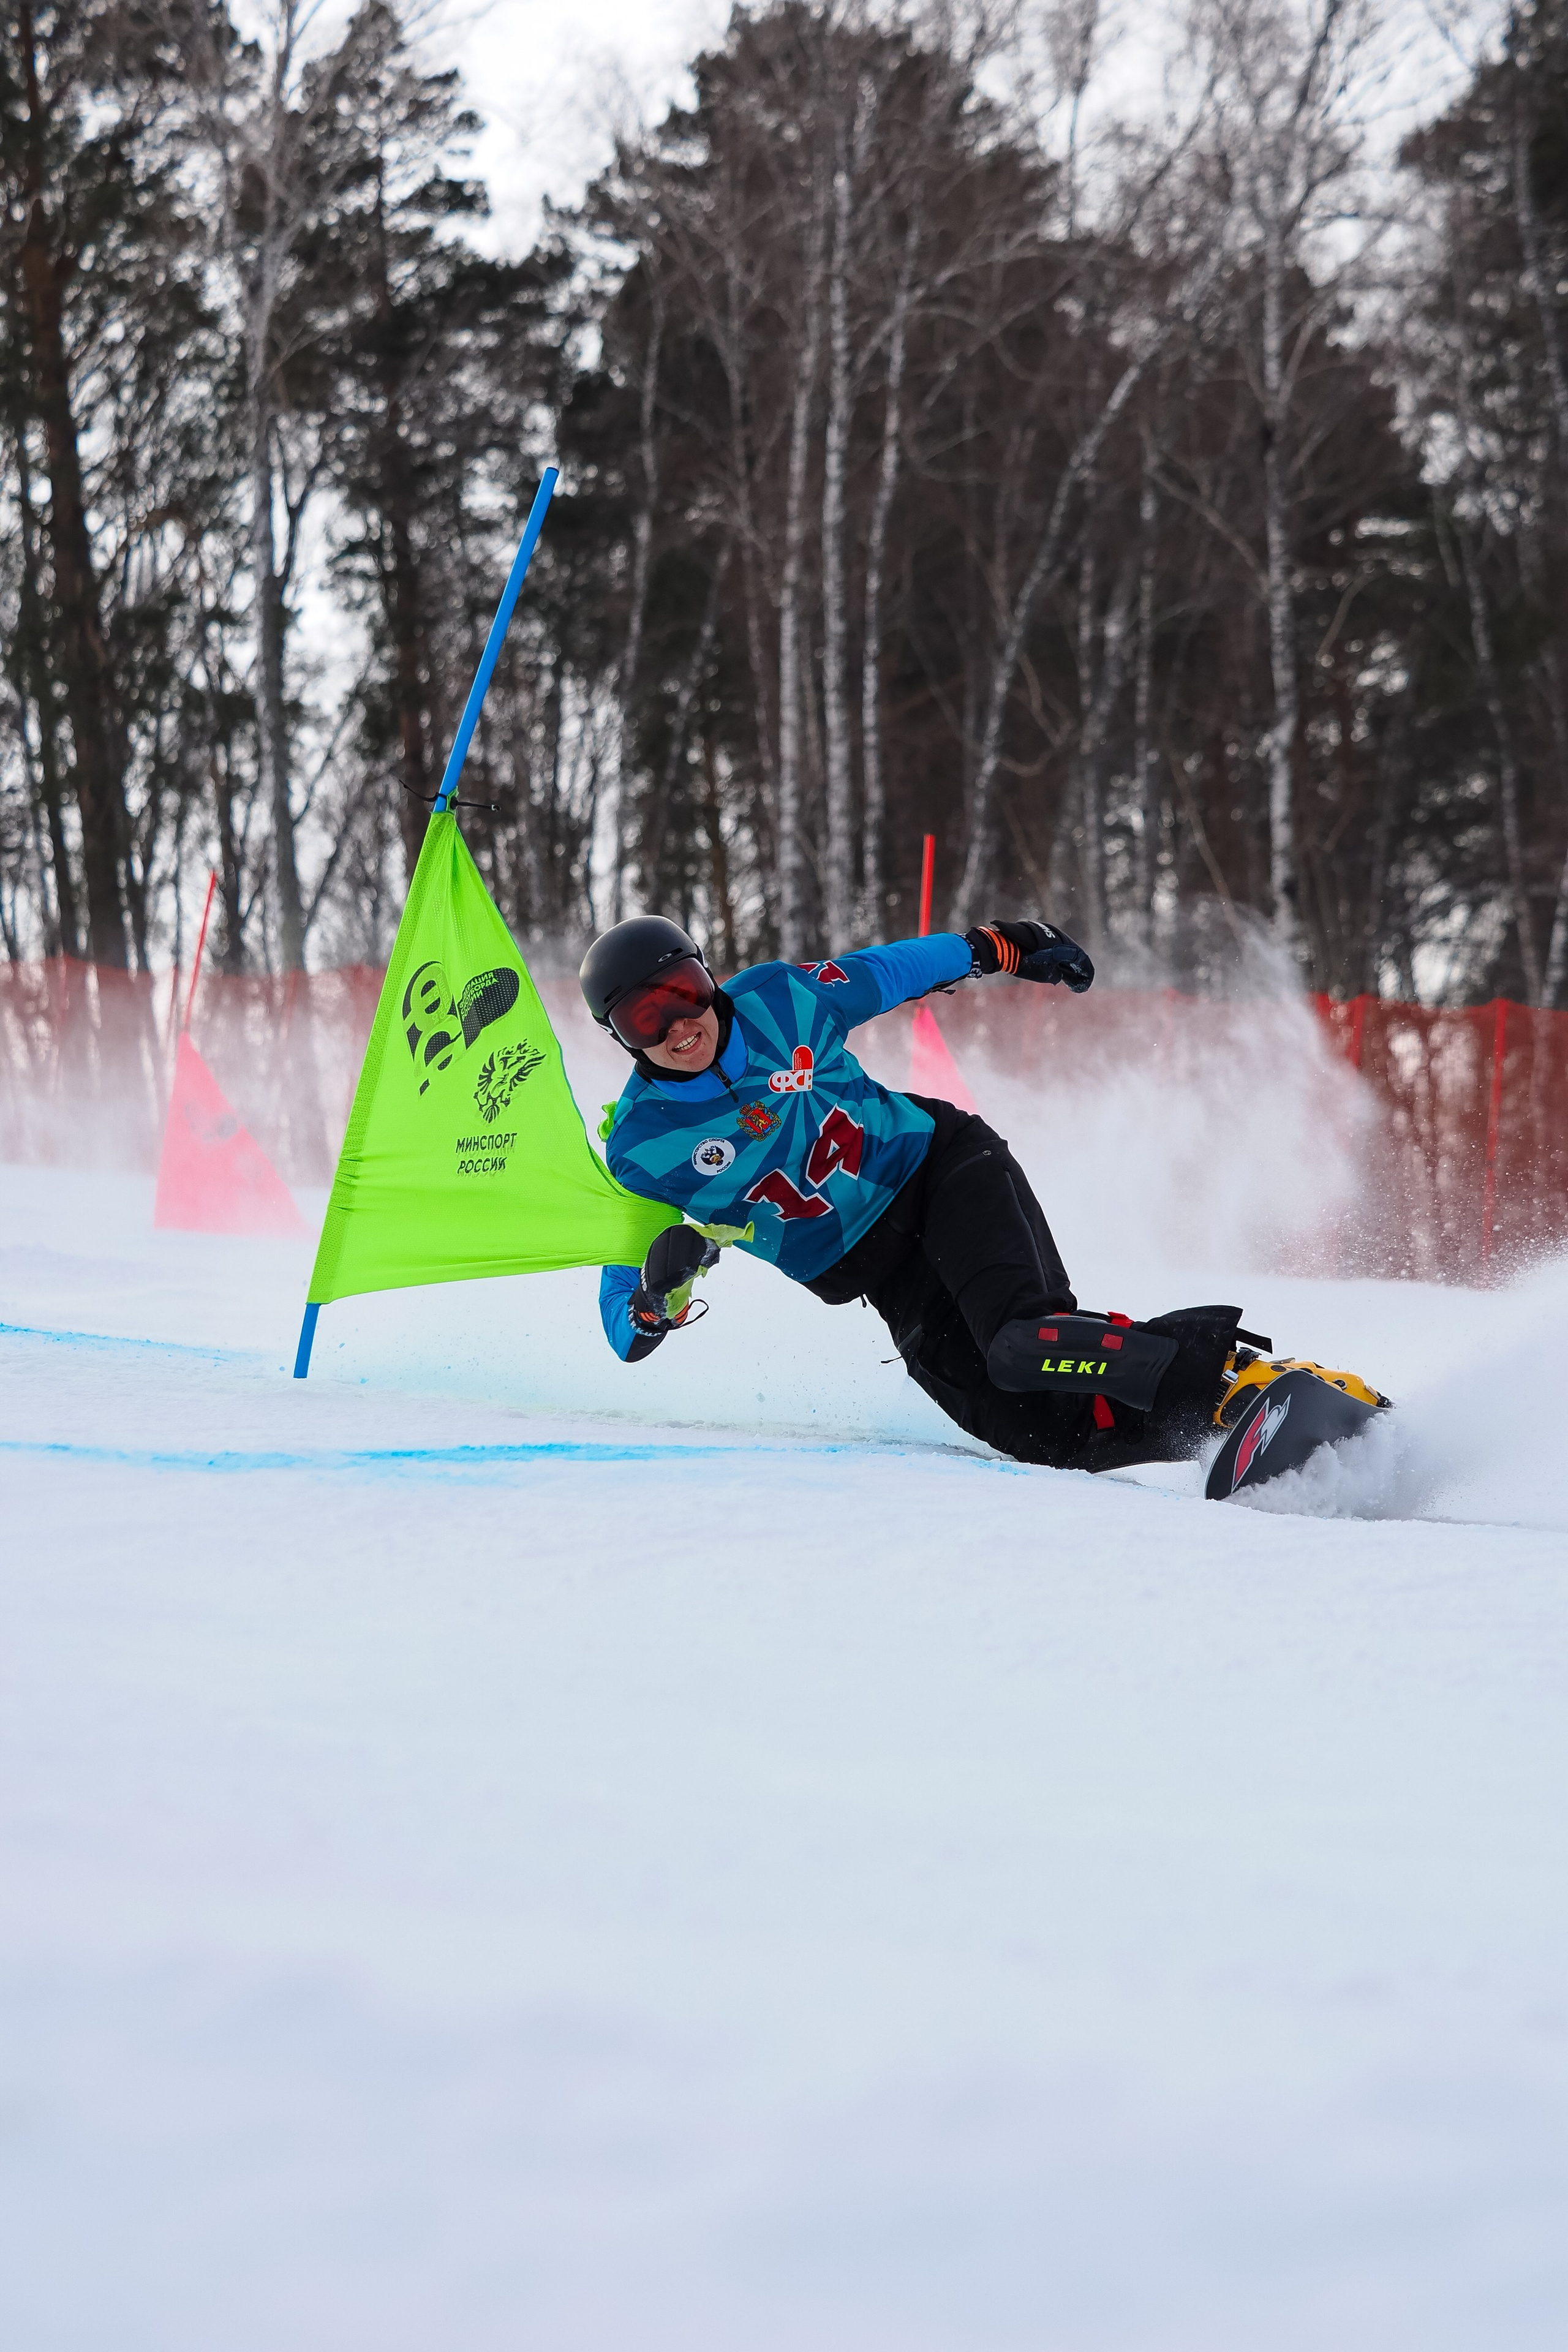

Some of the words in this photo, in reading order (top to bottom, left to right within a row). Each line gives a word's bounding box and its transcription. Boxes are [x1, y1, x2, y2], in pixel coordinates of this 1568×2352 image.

[459, 972, 494, 1008] ФДЕРАЦИЯ
[455, 1133, 518, 1153] МИНСПОРТ
[457, 1156, 507, 1174] РОССИИ
[743, 1102, 865, 1223] 14
[1041, 1359, 1107, 1374] LEKI
